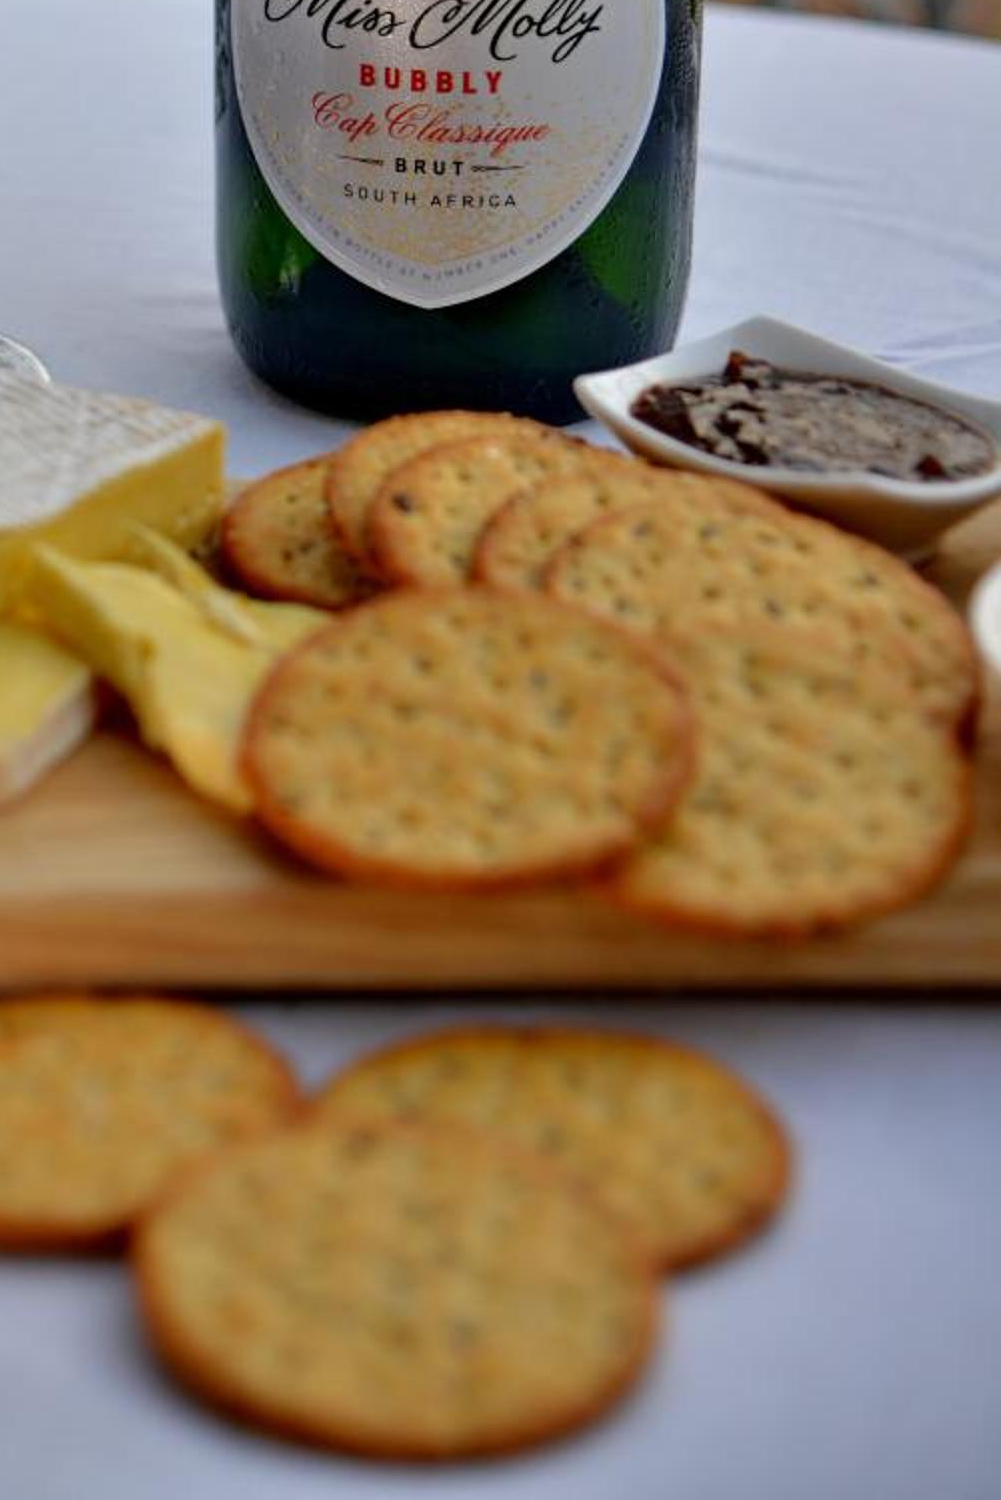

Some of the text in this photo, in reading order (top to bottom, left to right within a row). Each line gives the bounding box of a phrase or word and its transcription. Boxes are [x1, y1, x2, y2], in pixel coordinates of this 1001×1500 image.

[359, 63, 504, 95] BUBBLY
[310, 90, 379, 143] Cap
[384, 100, 554, 159] Classique
[394, 156, 465, 177] BRUT
[342, 181, 518, 209] SOUTH AFRICA
